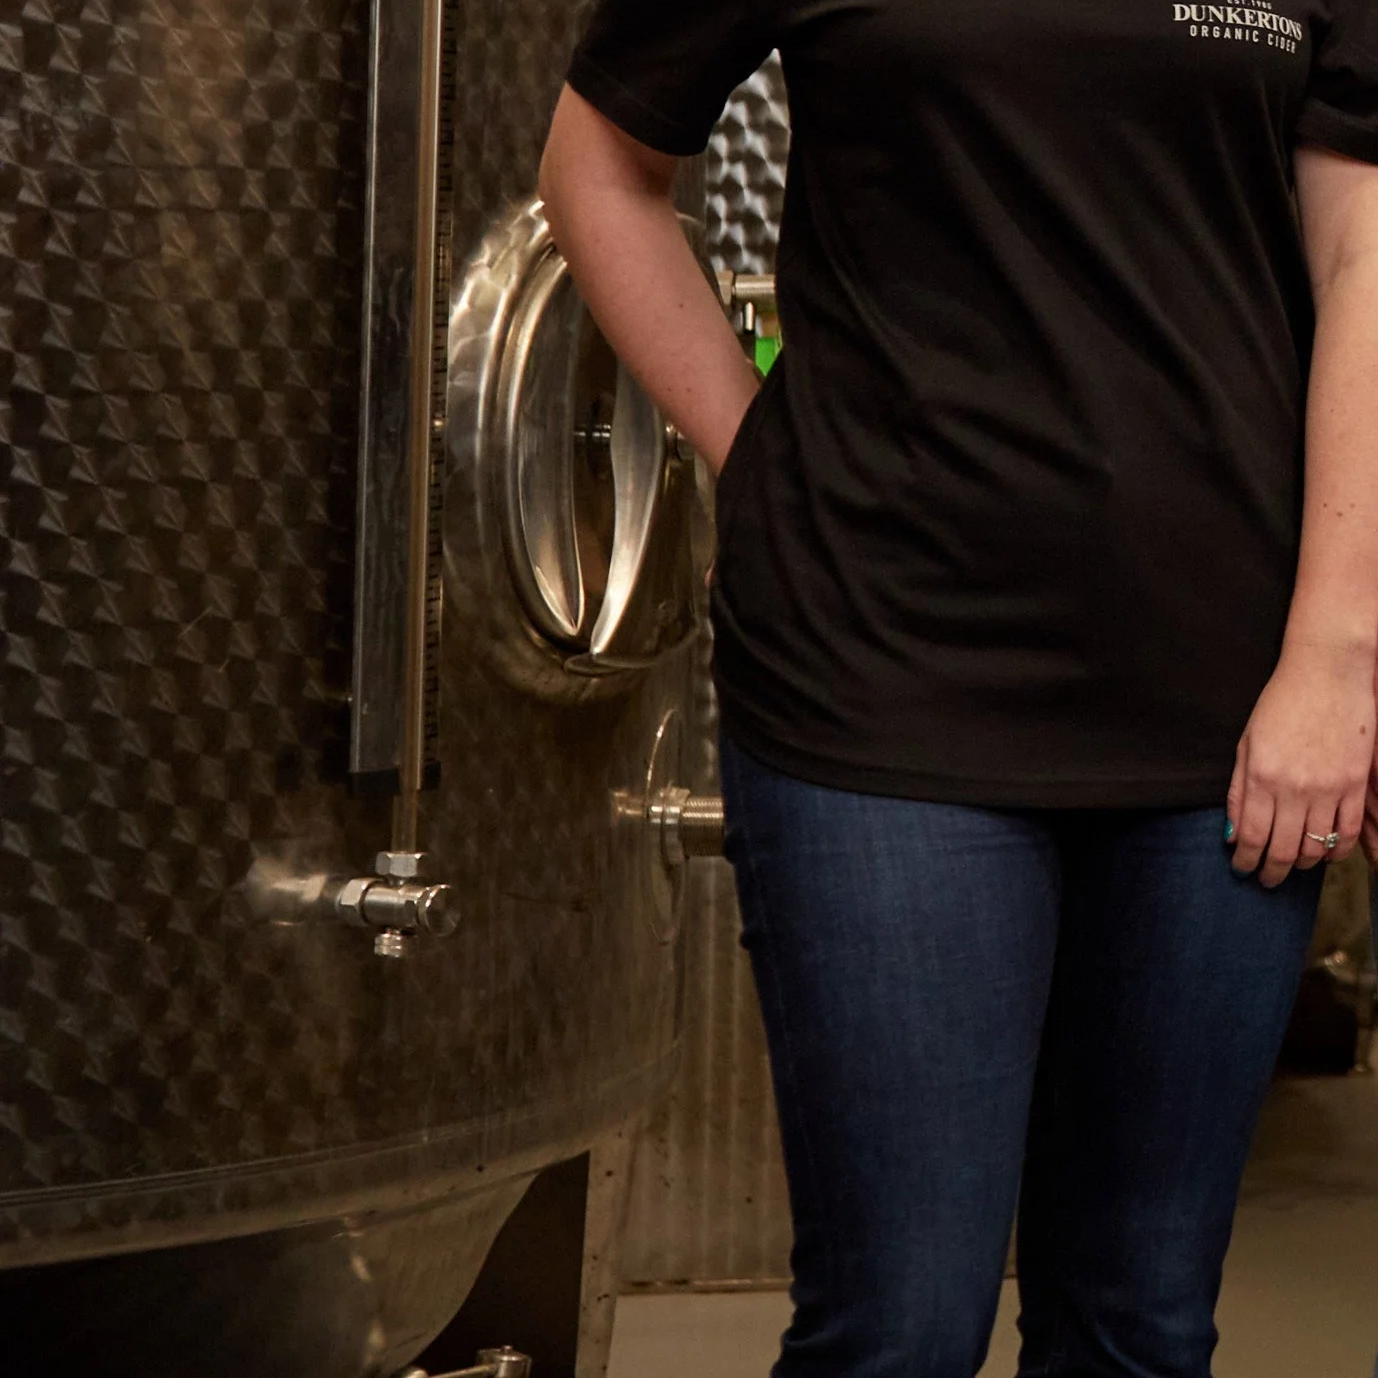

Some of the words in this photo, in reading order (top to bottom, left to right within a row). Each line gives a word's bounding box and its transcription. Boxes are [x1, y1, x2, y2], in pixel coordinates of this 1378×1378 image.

[1172, 3, 1303, 41] DUNKERTONS
[1190, 25, 1260, 43] ORGANIC
[1267, 33, 1296, 54] CIDER
